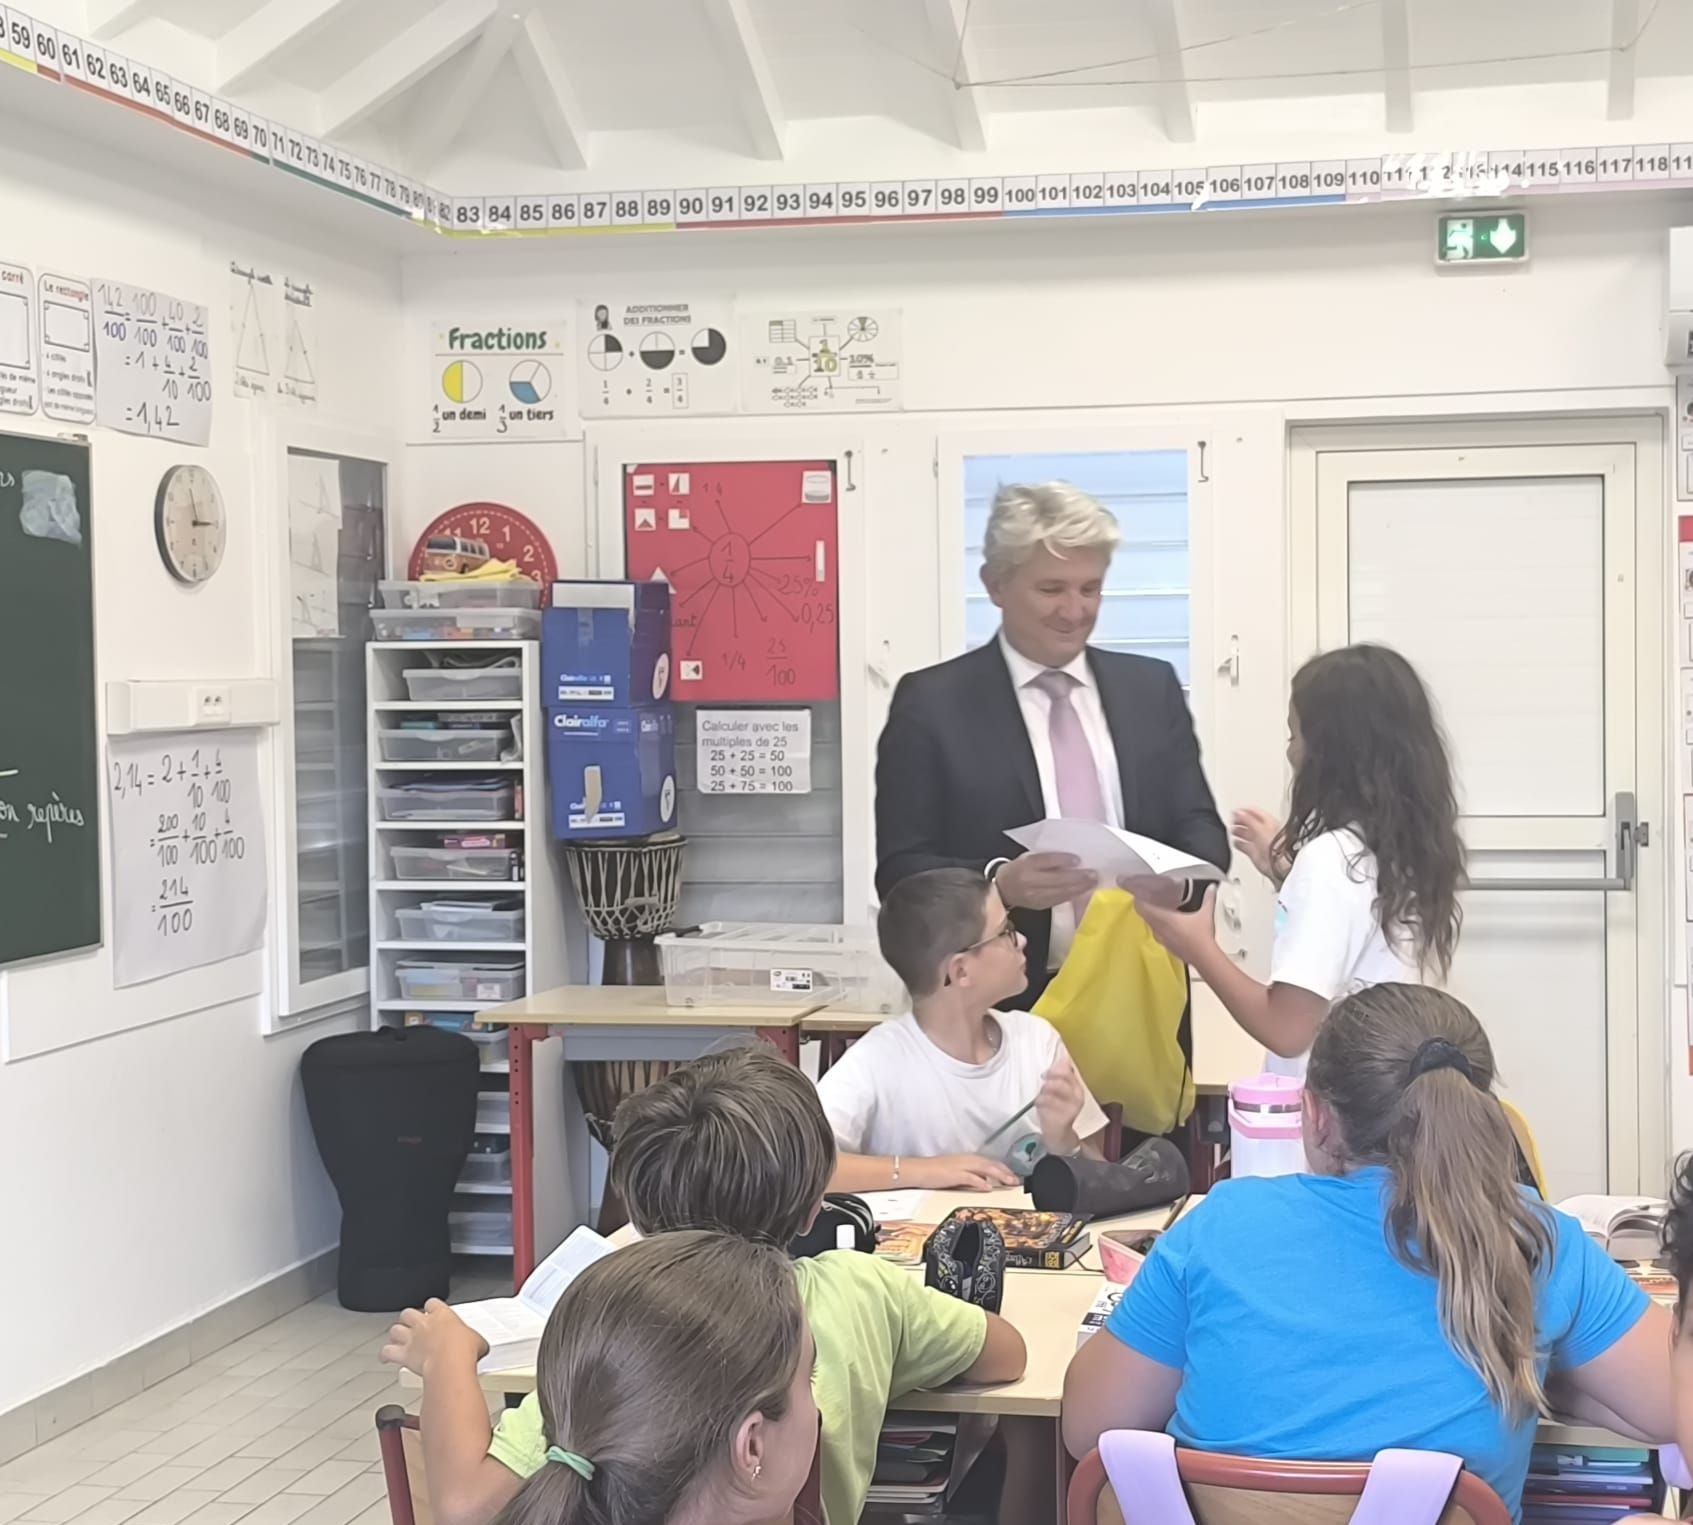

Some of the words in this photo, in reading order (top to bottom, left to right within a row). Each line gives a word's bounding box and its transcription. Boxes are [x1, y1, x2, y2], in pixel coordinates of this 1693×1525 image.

[12, 22, 30, 48] 59
[37, 33, 56, 60] 60
[62, 44, 80, 70] 61
[86, 54, 106, 79] 62
[110, 63, 128, 88] 63
[132, 72, 150, 96] 64
[156, 81, 170, 105] 65
[174, 92, 190, 116] 66
[195, 100, 210, 123] 67
[214, 109, 230, 132] 68
[234, 118, 248, 140] 69
[253, 125, 266, 148] 70
[272, 132, 284, 153] 71
[289, 139, 302, 161] 72
[306, 146, 319, 167] 73
[322, 153, 335, 174] 74
[338, 159, 351, 180] 75
[354, 166, 366, 186] 76
[370, 172, 381, 192] 77
[385, 178, 396, 198] 78
[399, 184, 410, 204] 79
[457, 206, 480, 223] 83
[488, 205, 511, 222] 84
[519, 204, 544, 222] 85
[551, 204, 575, 221] 86
[583, 202, 608, 219] 87
[615, 200, 638, 218] 88
[647, 199, 670, 216] 89
[679, 197, 702, 215] 90
[711, 196, 734, 213] 91
[744, 194, 768, 212] 92
[776, 193, 800, 210] 93
[808, 192, 834, 209] 94
[841, 190, 866, 208] 95
[874, 190, 900, 208] 96
[907, 189, 933, 207] 97
[940, 188, 966, 205] 98
[974, 186, 999, 203] 99
[1005, 188, 1035, 203] 100
[1038, 186, 1069, 202] 101
[1072, 186, 1102, 200] 102
[1106, 184, 1136, 199] 103
[1140, 182, 1171, 197] 104
[1174, 181, 1204, 196] 105
[1210, 179, 1240, 194] 106
[1243, 176, 1275, 192] 107
[1278, 174, 1310, 190] 108
[1313, 173, 1344, 188] 109
[1348, 171, 1380, 186] 110
[1420, 165, 1450, 180] 12
[1526, 161, 1558, 177] 115
[1562, 159, 1595, 174] 116
[1599, 158, 1632, 174] 117
[1635, 157, 1668, 172] 118
[98, 284, 122, 309] 142
[133, 292, 156, 317] 100
[192, 305, 203, 327] 2
[104, 320, 126, 341] 100
[134, 327, 157, 347] 100
[167, 336, 186, 353] 100
[191, 338, 208, 360] 100
[448, 327, 547, 350] Fractions
[135, 351, 144, 368] 1
[189, 356, 198, 372] 2
[162, 378, 178, 400] 10
[187, 380, 211, 402] 100
[136, 402, 180, 433] 1,42
[442, 410, 456, 420] un
[459, 408, 486, 420] demi
[509, 410, 523, 420] un
[526, 408, 554, 421] tiers
[432, 421, 441, 433] 2
[470, 517, 490, 534] 12
[502, 525, 510, 542] 1
[523, 545, 534, 562] 2
[721, 542, 732, 556] 1
[722, 565, 733, 583] 4
[802, 602, 834, 633] 0,25
[722, 651, 745, 670] 1/4
[767, 664, 796, 686] 100
[554, 714, 609, 728] Clairalfa
[702, 720, 749, 732] Calculer
[752, 723, 779, 732] avec
[782, 721, 799, 732] les
[702, 737, 752, 748] multiples
[756, 736, 770, 747] de
[773, 736, 788, 747] 25
[710, 750, 725, 761] 25
[740, 750, 755, 761] 25
[770, 750, 785, 761] 50
[114, 762, 142, 800] 2,14
[162, 754, 172, 783] 2
[191, 749, 200, 768] 1
[710, 765, 725, 776] 50
[740, 765, 755, 776] 50
[771, 766, 792, 776] 100
[187, 782, 204, 808] 10
[210, 779, 231, 803] 100
[710, 780, 725, 791] 25
[741, 781, 755, 791] 75
[772, 781, 793, 791] 100
[27, 792, 84, 843] repères
[157, 813, 178, 833] 200
[192, 812, 206, 832] 10
[157, 844, 178, 868] 100
[190, 839, 217, 865] 100
[222, 836, 245, 860] 100
[159, 875, 189, 900] 214
[157, 908, 193, 937] 100
